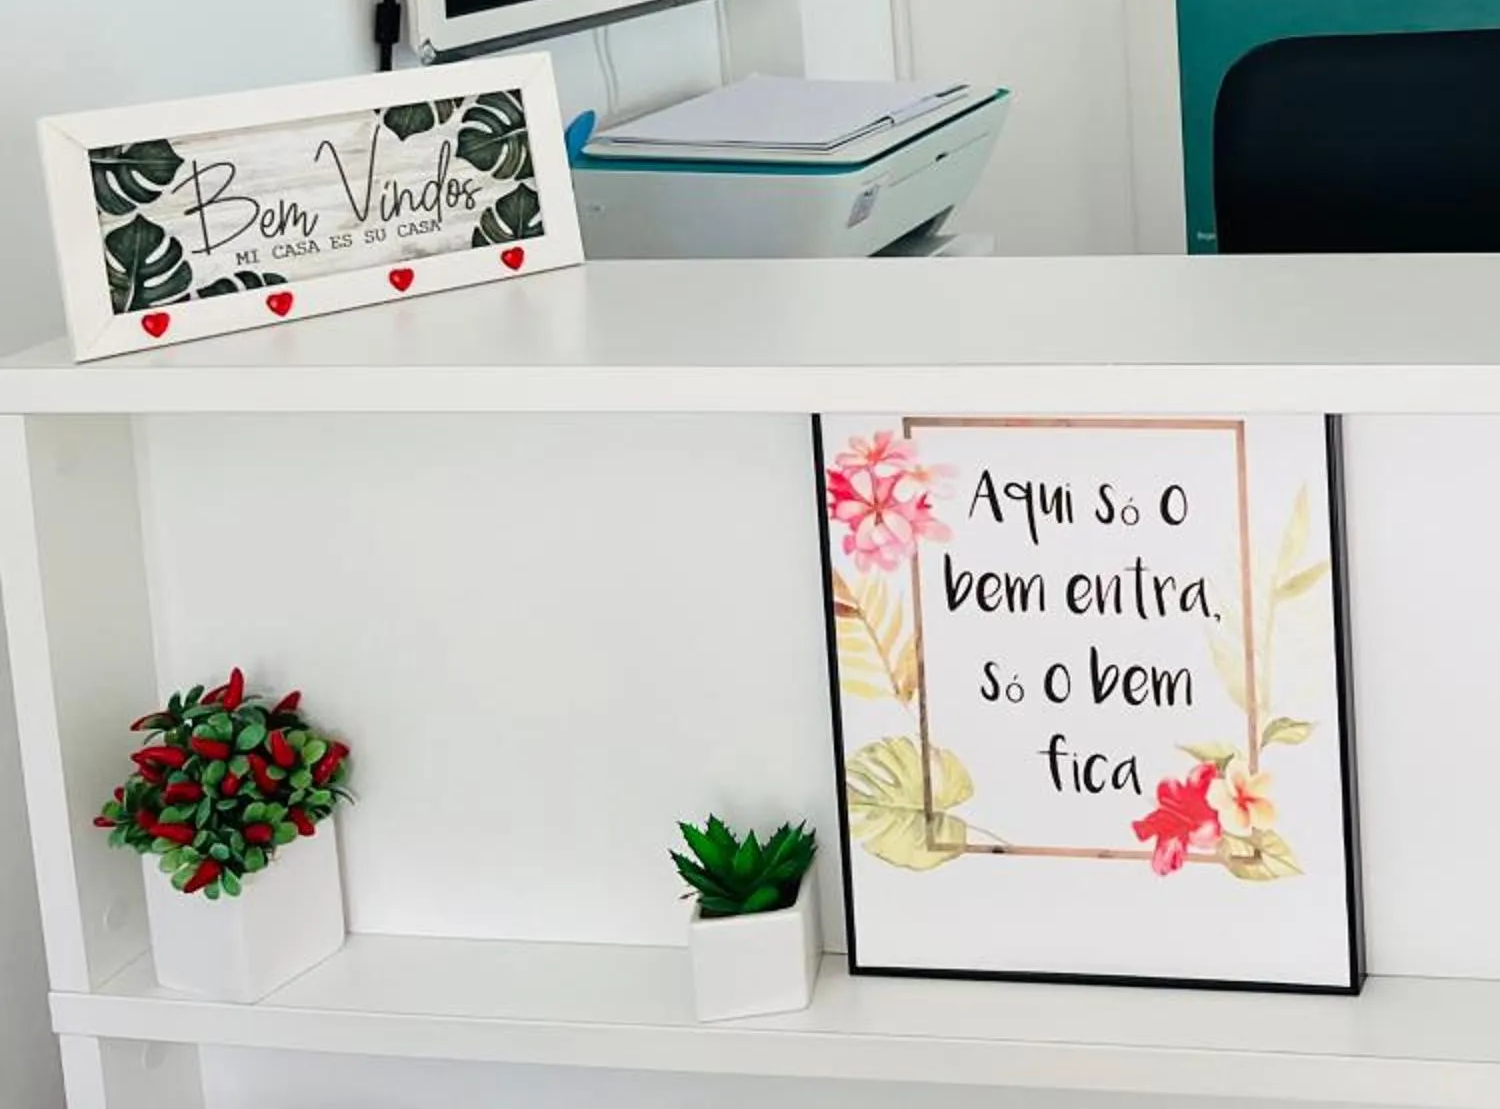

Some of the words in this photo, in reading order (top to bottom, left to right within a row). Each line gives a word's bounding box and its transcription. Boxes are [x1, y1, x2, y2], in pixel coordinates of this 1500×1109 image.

[172, 159, 318, 255] Bem
[314, 124, 482, 226] Vindos
[236, 250, 261, 266] MI
[272, 240, 321, 260] CASA
[331, 234, 354, 251] ES
[363, 227, 387, 245] SU
[397, 219, 443, 239] CASA
[968, 468, 1074, 545] Aqui
[943, 553, 1046, 613] bem
[1065, 557, 1222, 622] entra,
[1089, 646, 1192, 706] bem
[1037, 733, 1142, 795] fica
